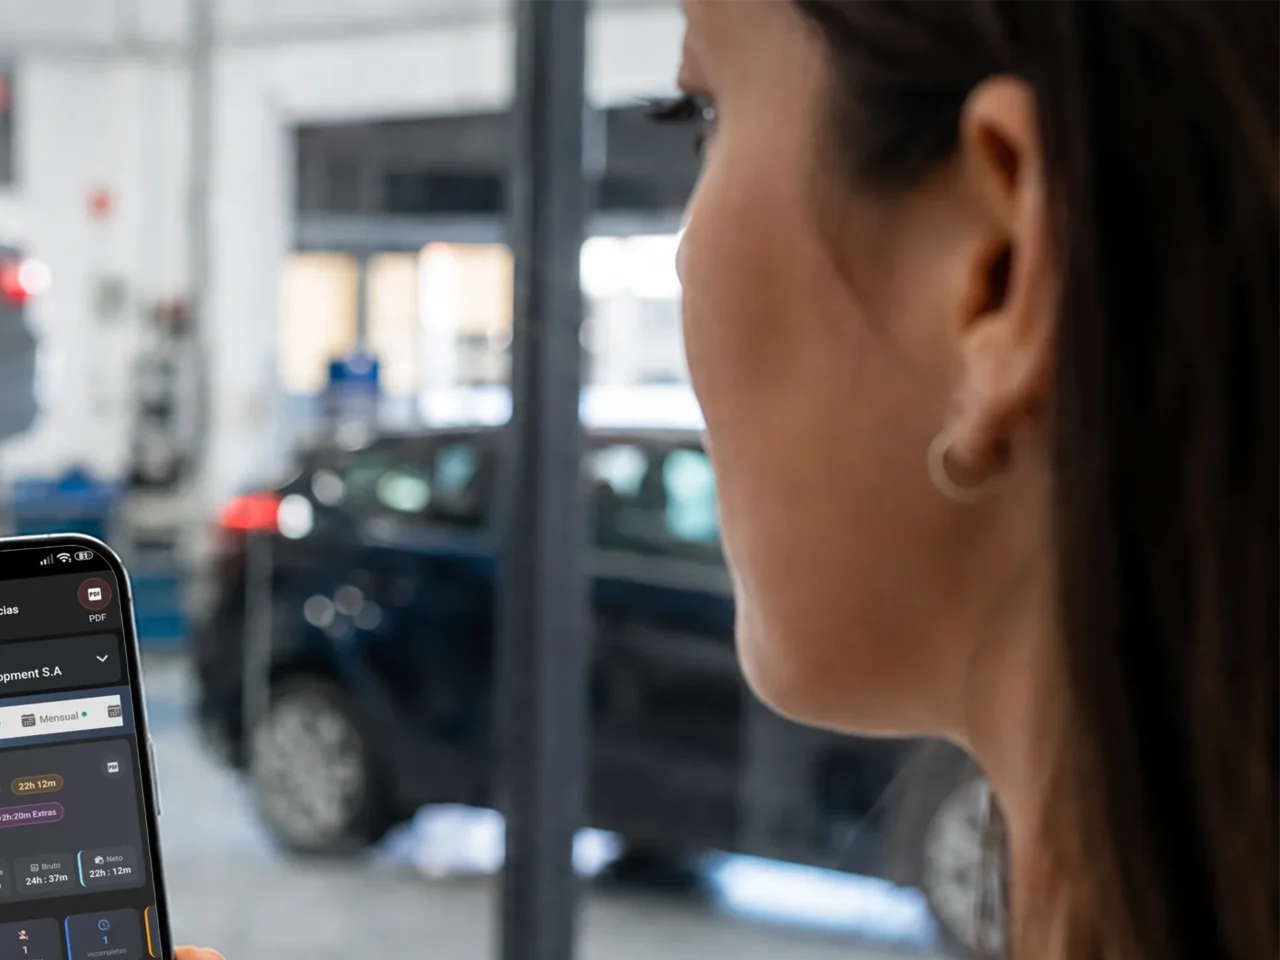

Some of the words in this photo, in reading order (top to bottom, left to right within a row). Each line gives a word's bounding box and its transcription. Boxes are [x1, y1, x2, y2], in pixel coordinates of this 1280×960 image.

[89, 614, 107, 622] PDF
[42, 666, 62, 677] S.A
[40, 712, 79, 724] Mensual
[18, 781, 36, 791] 22h
[38, 780, 56, 789] 12m
[32, 809, 57, 818] Extras
[89, 869, 106, 878] 22h
[113, 867, 132, 875] 12m
[26, 877, 43, 886] 24h
[48, 874, 68, 883] 37m
